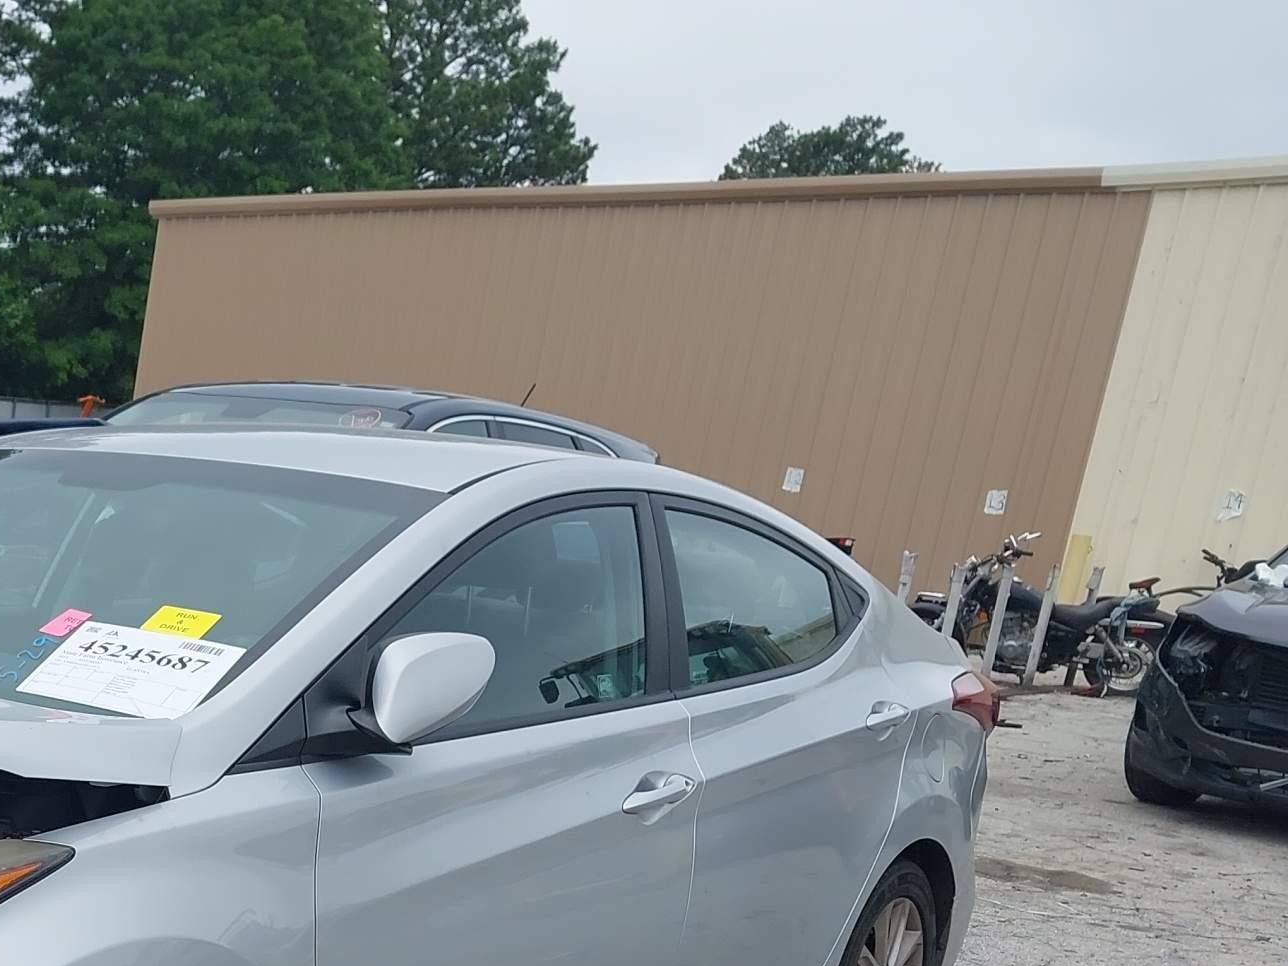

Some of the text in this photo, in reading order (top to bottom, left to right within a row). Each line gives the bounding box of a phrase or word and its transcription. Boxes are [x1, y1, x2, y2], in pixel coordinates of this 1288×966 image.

[175, 611, 199, 621] RUN
[158, 623, 191, 633] DRIVE
[78, 639, 212, 674] 45245687
